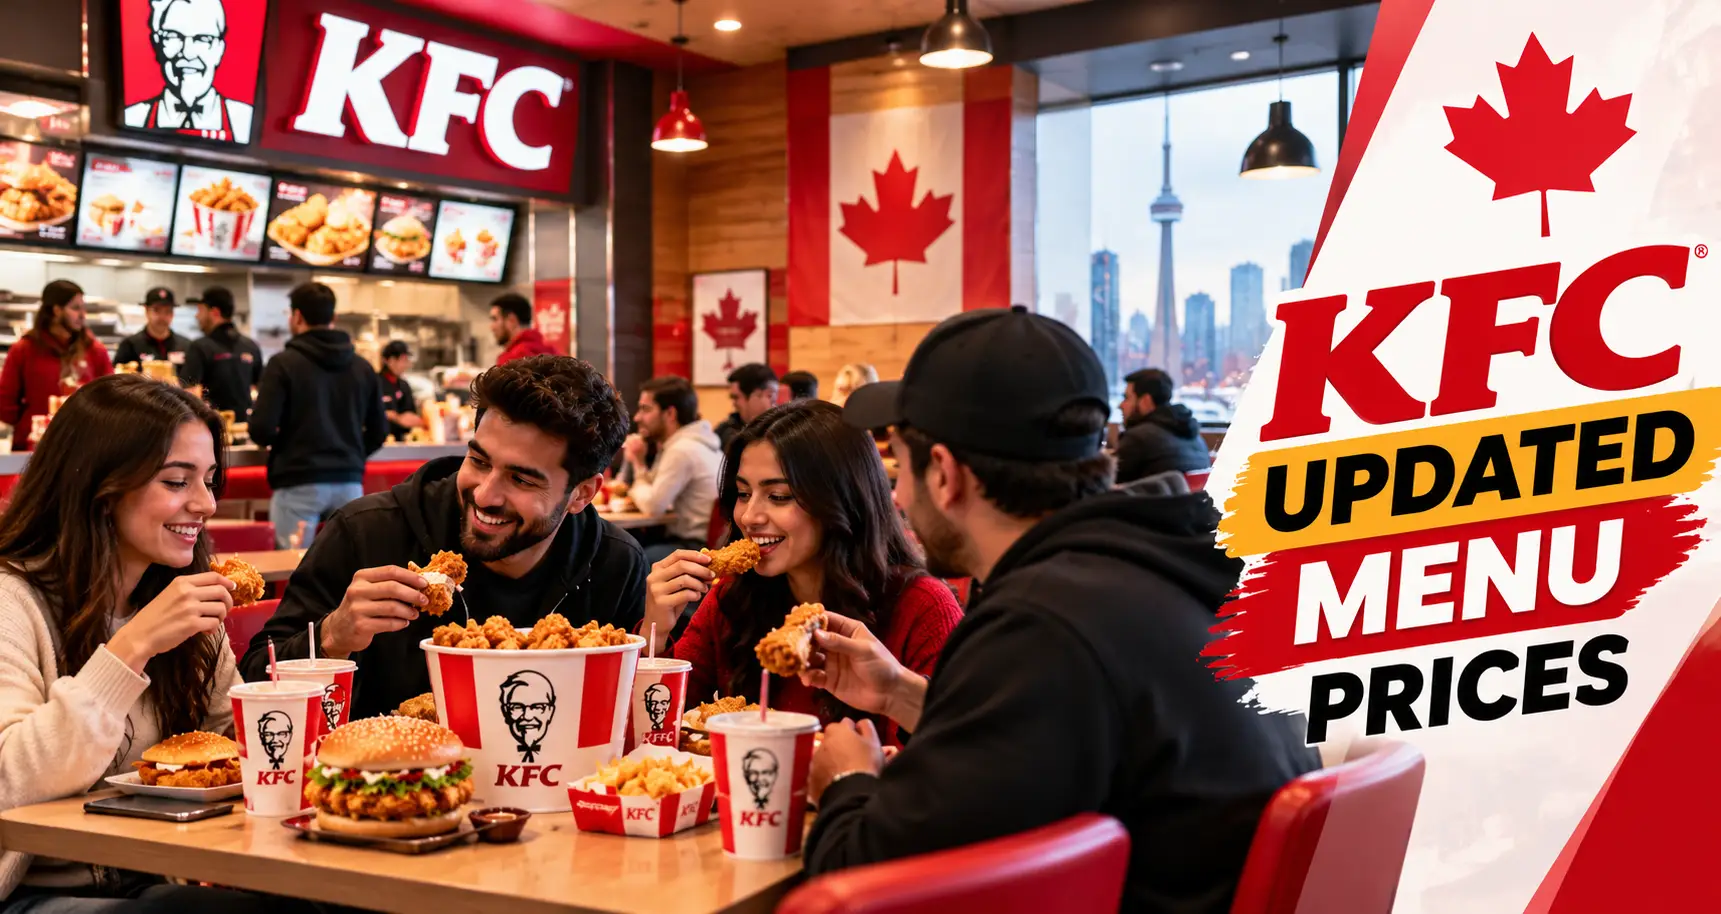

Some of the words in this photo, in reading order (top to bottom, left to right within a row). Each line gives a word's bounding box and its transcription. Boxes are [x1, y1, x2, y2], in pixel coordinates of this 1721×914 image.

[294, 12, 565, 170] KFC
[257, 769, 296, 785] KFC
[494, 764, 563, 787] KFC
[626, 807, 655, 821] KFC
[740, 809, 782, 827] KFC
